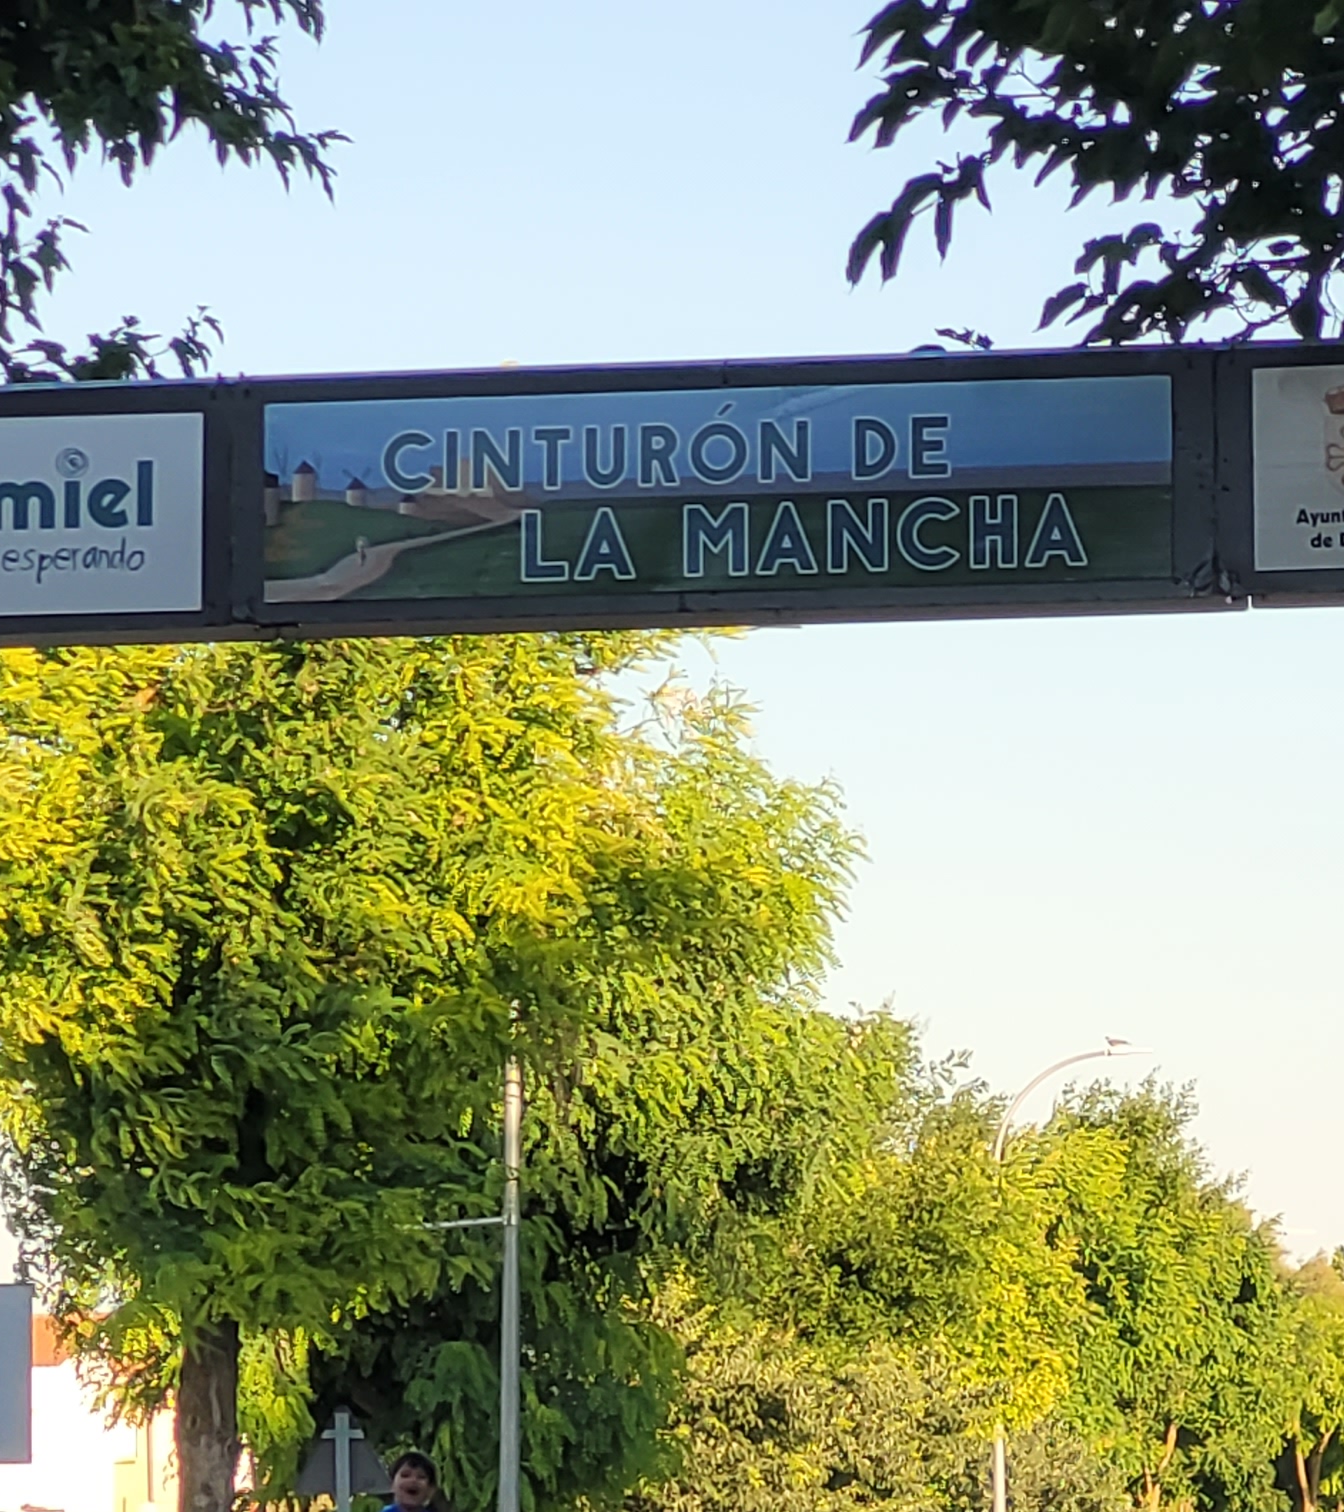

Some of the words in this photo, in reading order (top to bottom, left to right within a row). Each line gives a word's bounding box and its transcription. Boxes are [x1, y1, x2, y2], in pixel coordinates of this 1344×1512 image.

[382, 403, 811, 491] CINTURÓN
[853, 415, 952, 480] DE
[1, 537, 146, 584] esperando
[519, 507, 638, 583] LA
[681, 493, 1089, 579] MANCHA
[1311, 533, 1333, 548] de
